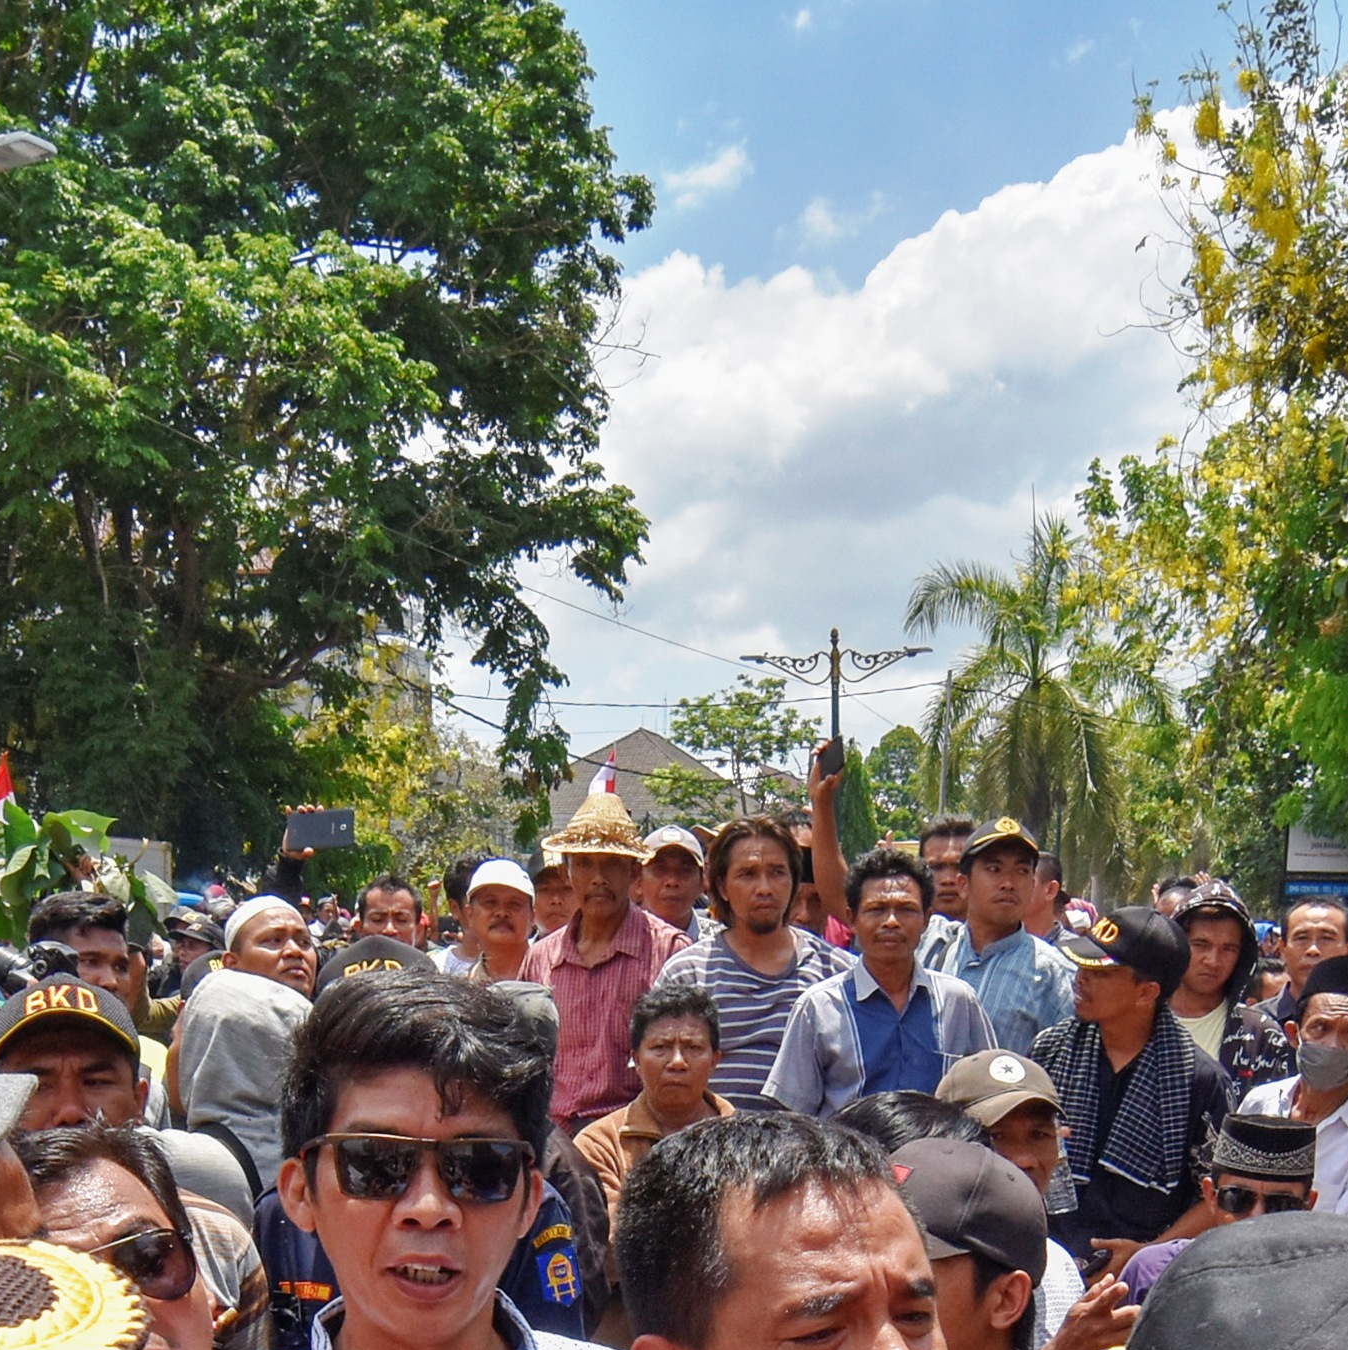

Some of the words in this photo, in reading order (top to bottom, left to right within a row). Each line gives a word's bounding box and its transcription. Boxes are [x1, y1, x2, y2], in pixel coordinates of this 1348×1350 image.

[1090, 916, 1120, 943] KD
[208, 958, 224, 973] BK
[25, 984, 99, 1016] BKD
